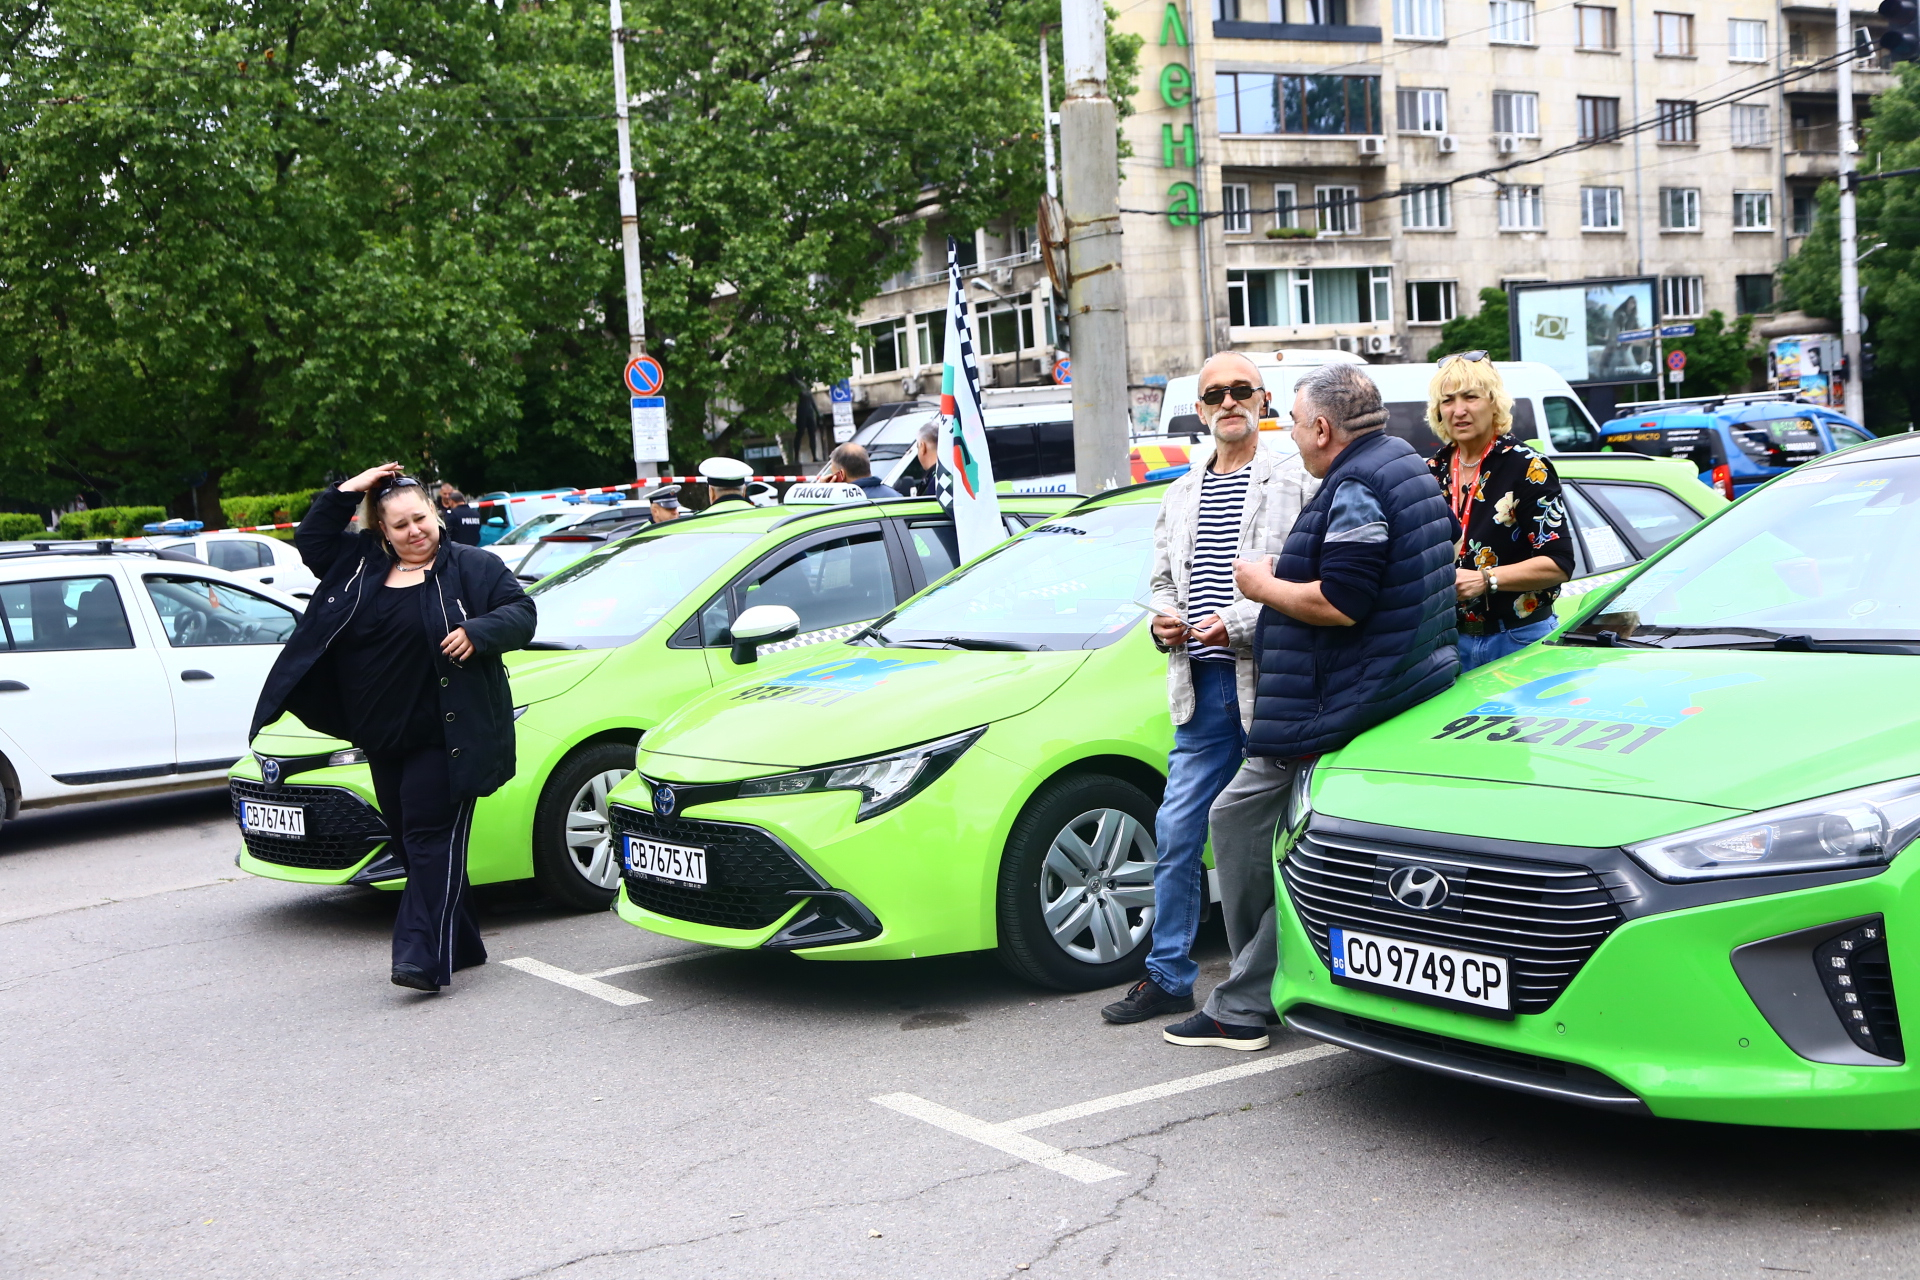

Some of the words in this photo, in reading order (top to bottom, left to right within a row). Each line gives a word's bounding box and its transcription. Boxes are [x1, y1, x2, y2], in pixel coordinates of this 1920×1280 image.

[793, 487, 834, 499] ТАКСИ
[842, 487, 862, 498] 7674
[729, 686, 857, 707] 9732121
[1476, 705, 1676, 724] СУПЕРТРАНС
[1430, 715, 1668, 755] 9732121
[1333, 957, 1344, 969] BG
[1347, 937, 1382, 978] CO
[1387, 945, 1456, 993] 9749
[1462, 958, 1502, 1001] CP
